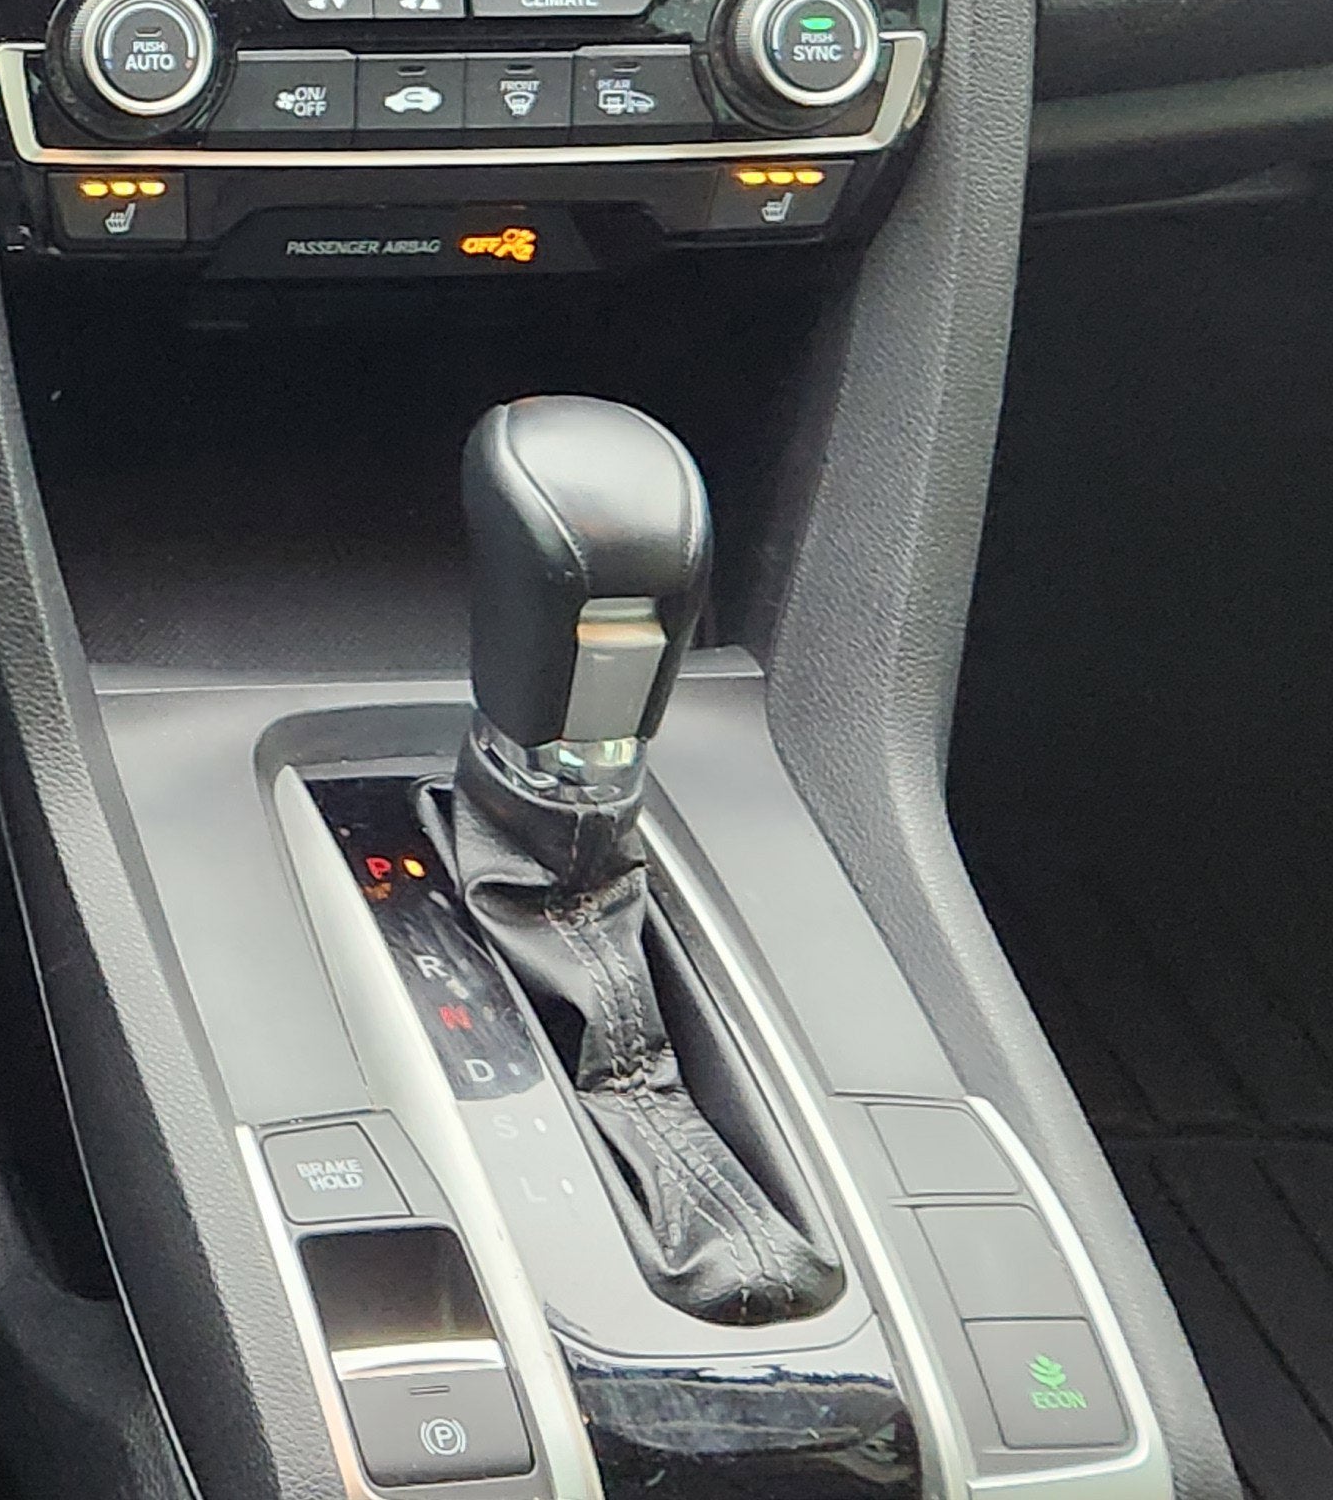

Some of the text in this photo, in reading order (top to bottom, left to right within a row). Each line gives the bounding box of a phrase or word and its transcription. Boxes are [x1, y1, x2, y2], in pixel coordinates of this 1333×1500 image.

[133, 40, 166, 52] PUSH
[800, 32, 833, 44] PUSH
[792, 45, 843, 62] SYNC
[124, 54, 175, 72] AUTO
[499, 80, 540, 93] FRONT
[597, 80, 631, 91] REAR
[293, 101, 328, 117] OFF
[286, 239, 380, 255] PASSENGER
[382, 239, 442, 255] AIRBAG
[414, 954, 449, 979] R
[464, 1058, 496, 1082] D
[296, 1155, 364, 1177] BRAKE
[308, 1172, 364, 1192] HOLD
[1030, 1389, 1088, 1409] ECON
